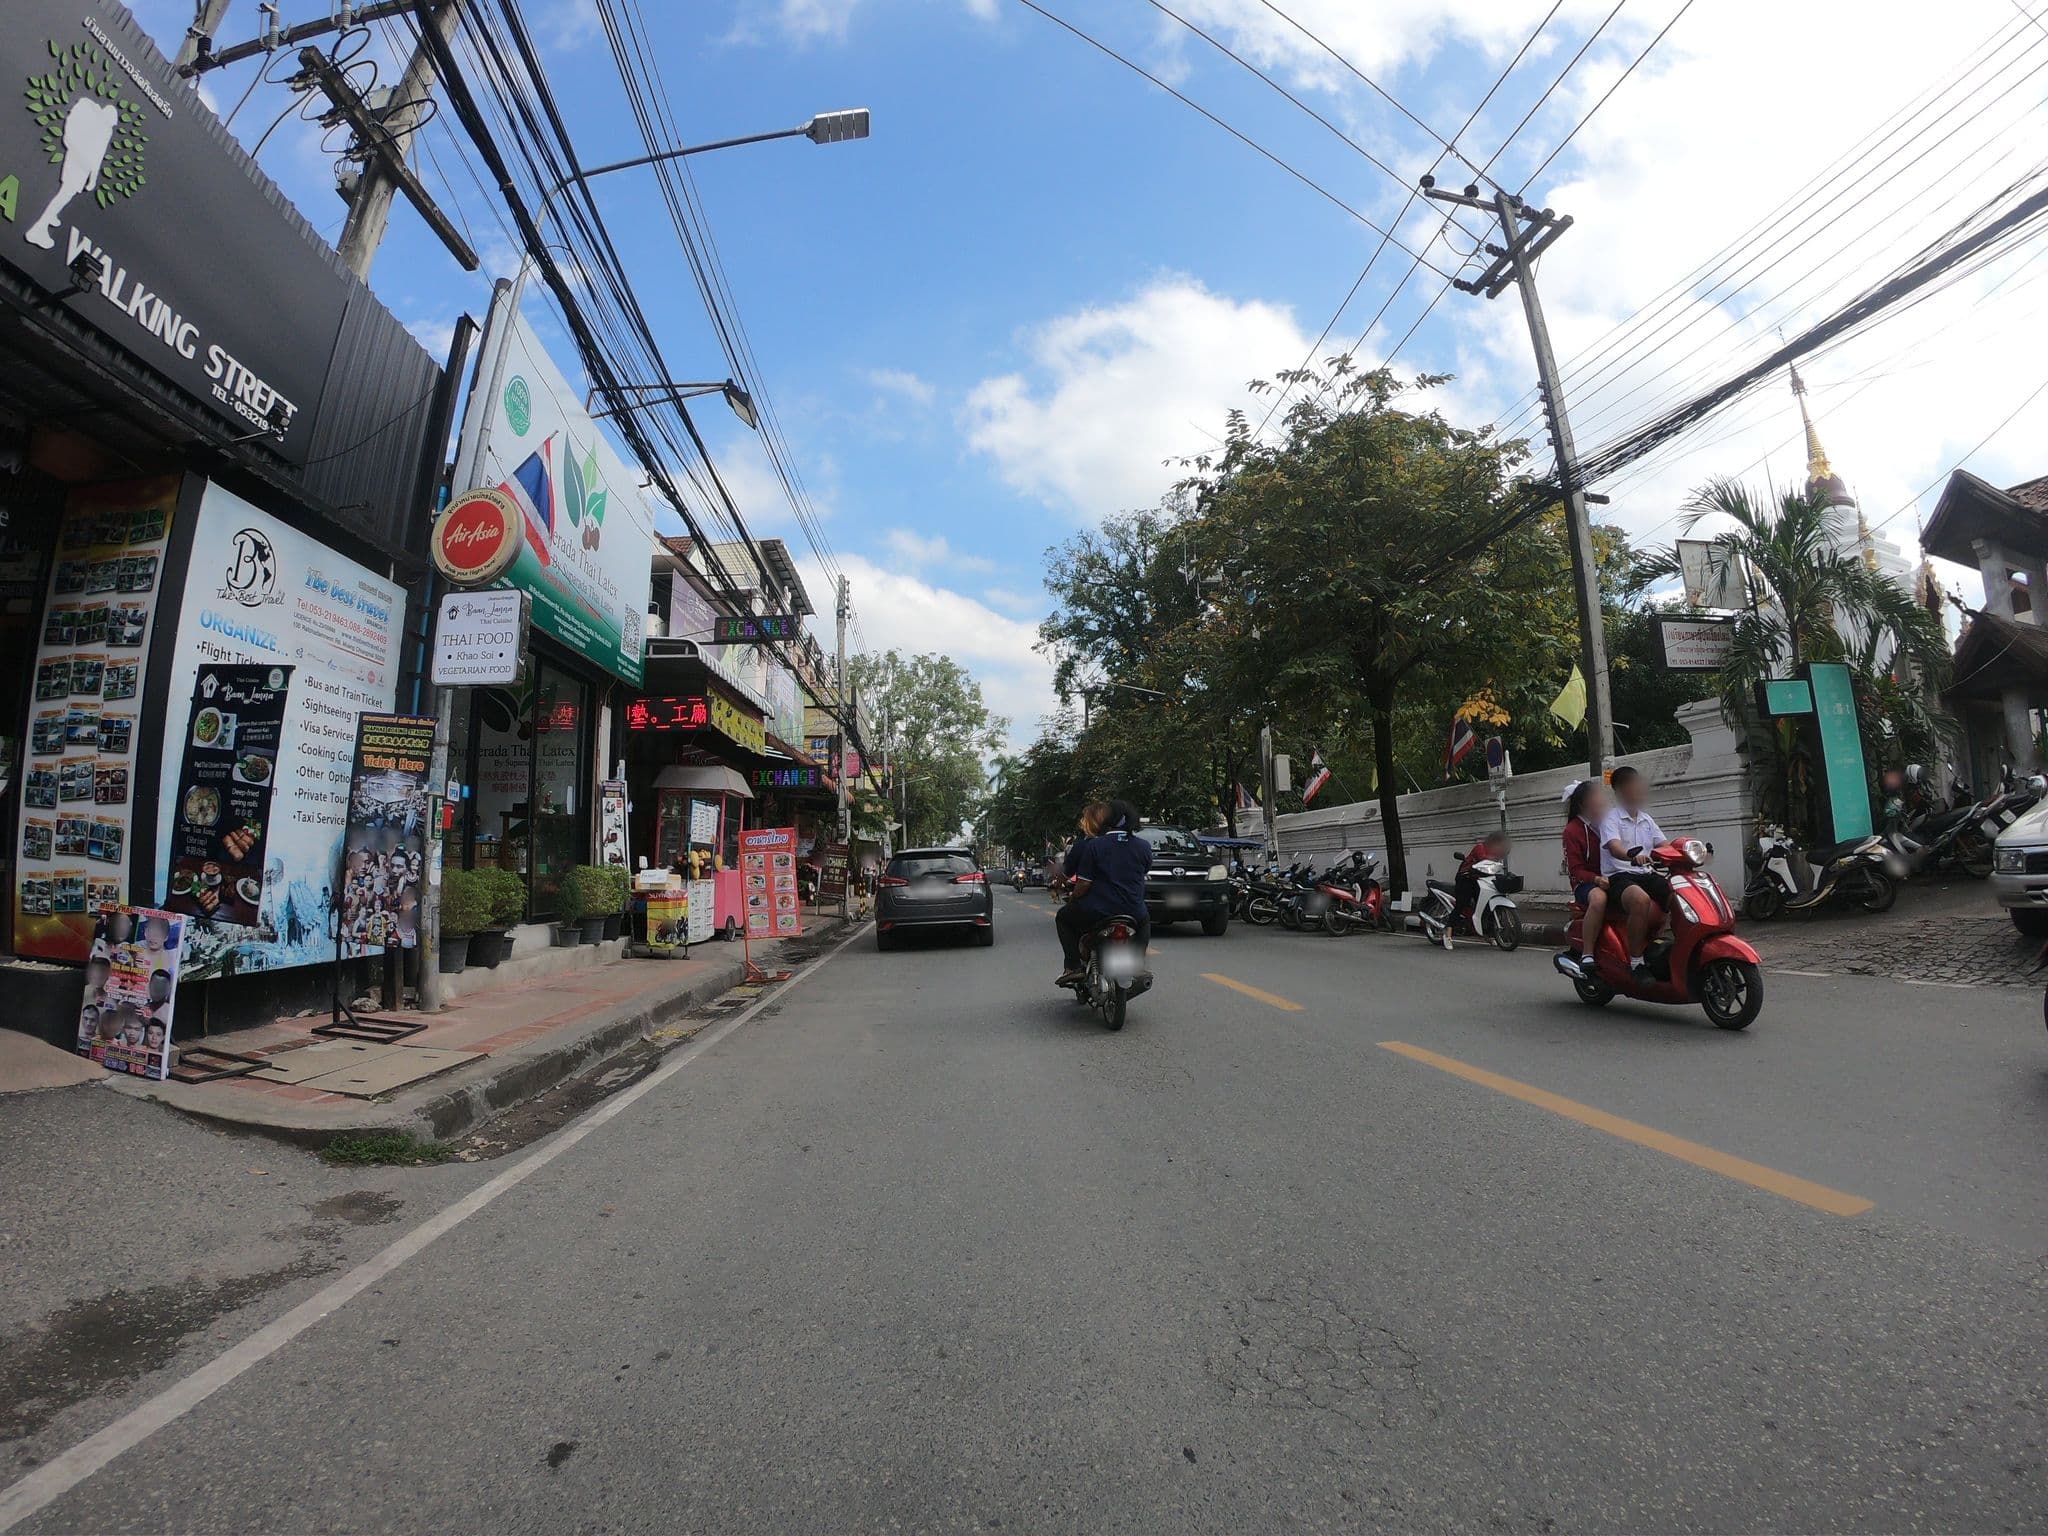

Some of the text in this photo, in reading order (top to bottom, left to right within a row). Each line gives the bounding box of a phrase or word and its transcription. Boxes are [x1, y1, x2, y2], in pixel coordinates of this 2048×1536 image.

[66, 226, 200, 359] WALKING
[720, 620, 790, 637] EXCHNGE
[442, 632, 514, 646] THAI FOOD
[201, 640, 231, 662] Flight
[456, 651, 478, 661] Khao
[438, 665, 511, 675] VEGETARIAN FOOD
[308, 675, 323, 691] Bus
[325, 681, 340, 696] and
[305, 698, 352, 723] Sightseeing
[303, 720, 321, 735] Visa
[323, 724, 354, 743] Services
[301, 743, 352, 763] Cooking Cou
[511, 744, 531, 757] Tha
[543, 744, 576, 757] Latex
[363, 754, 425, 772] Ticket Here
[300, 765, 351, 784] Other Optio
[752, 769, 816, 786] EXCHANGE
[298, 787, 328, 803] Private
[296, 811, 315, 824] Taxi
